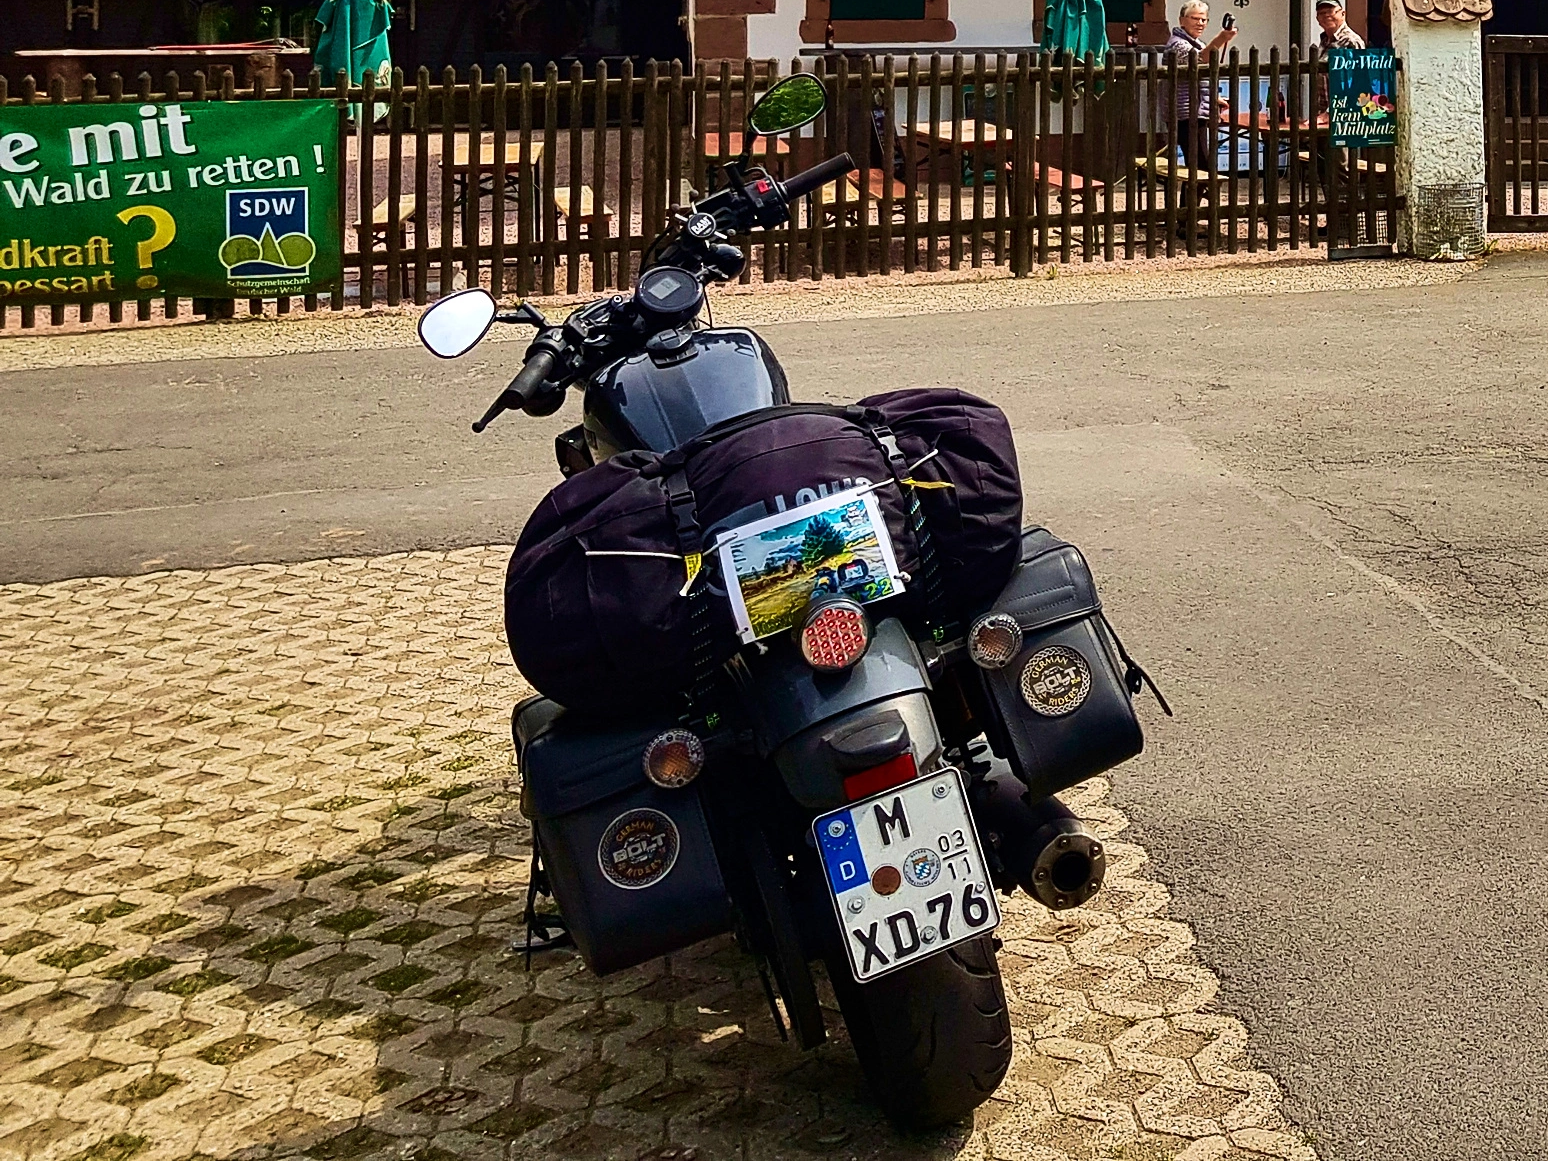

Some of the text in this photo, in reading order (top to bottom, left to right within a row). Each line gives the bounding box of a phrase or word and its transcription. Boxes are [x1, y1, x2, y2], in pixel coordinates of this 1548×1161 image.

[1331, 55, 1394, 70] Der Wald
[1332, 94, 1348, 109] ist
[1331, 108, 1361, 123] kein
[67, 103, 197, 167] mit
[1333, 120, 1396, 138] Müllplatz
[2, 170, 111, 209] Wald
[124, 169, 173, 197] zu
[187, 154, 301, 189] retten
[238, 197, 296, 218] SDW
[1048, 686, 1079, 706] RIDERS
[873, 796, 912, 846] M
[937, 829, 966, 853] 03
[839, 860, 856, 881] D
